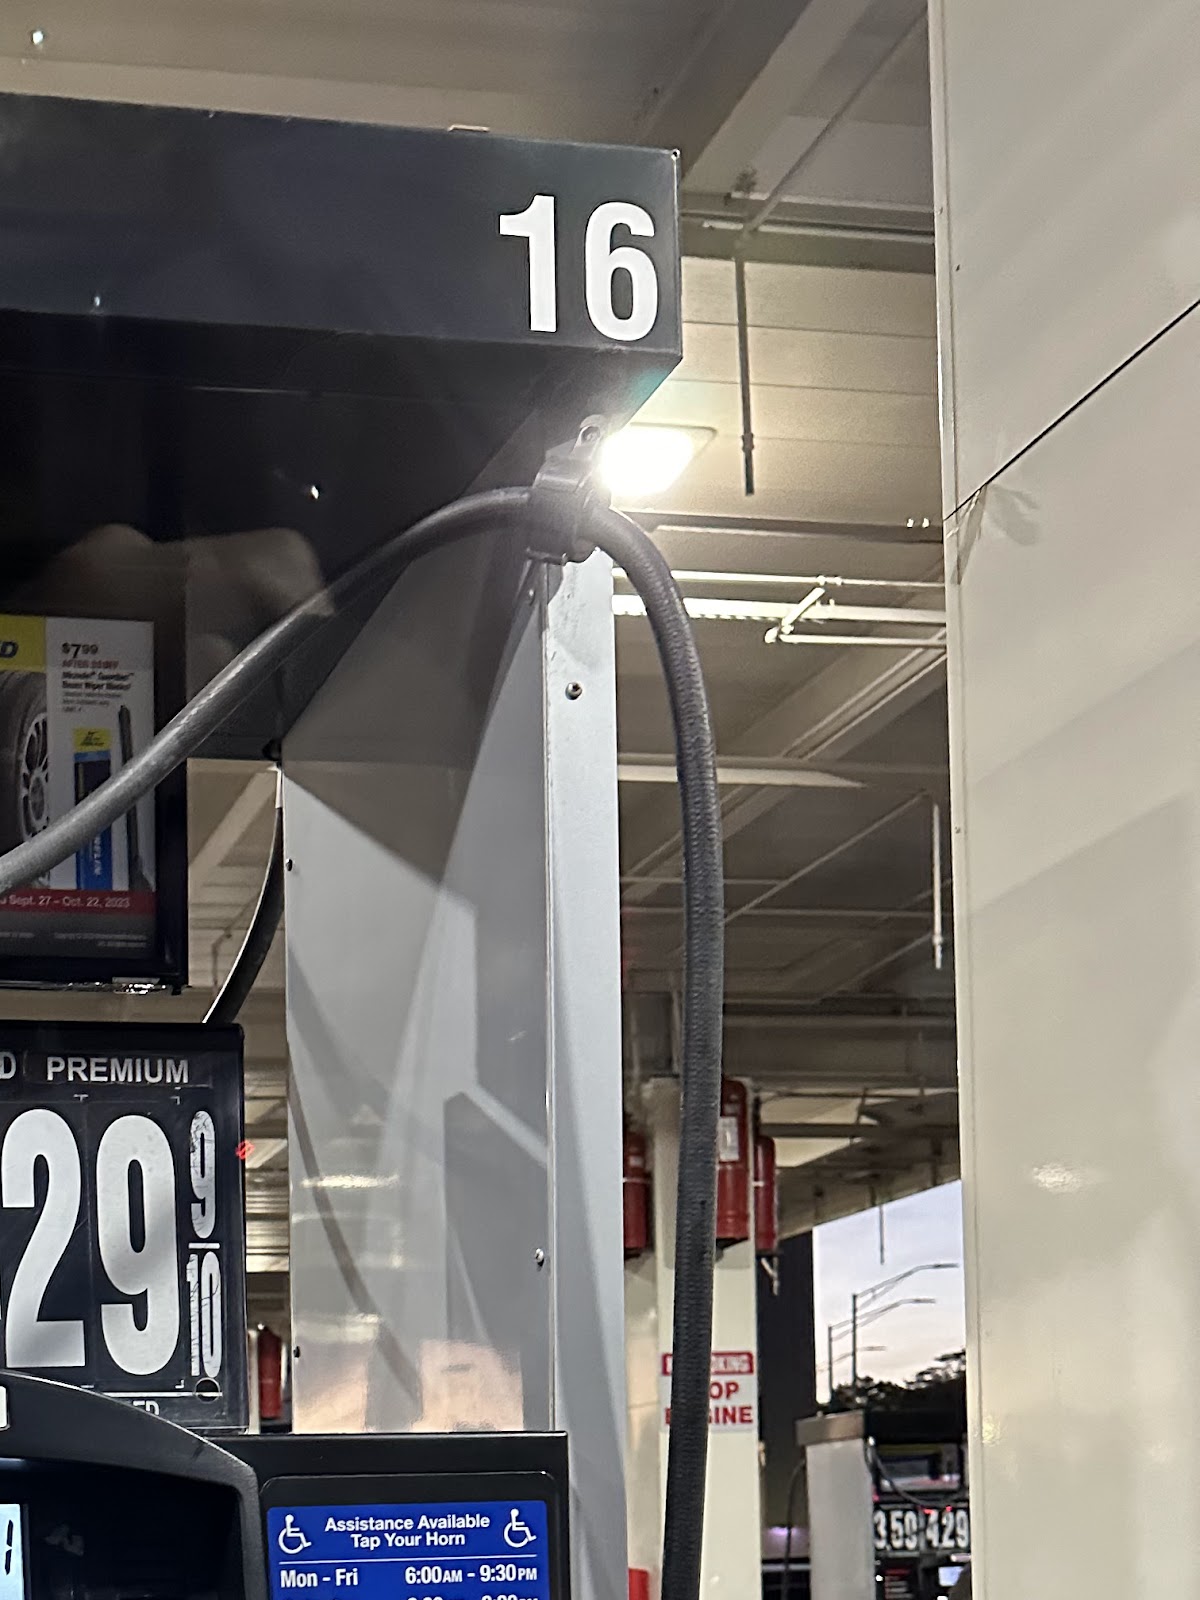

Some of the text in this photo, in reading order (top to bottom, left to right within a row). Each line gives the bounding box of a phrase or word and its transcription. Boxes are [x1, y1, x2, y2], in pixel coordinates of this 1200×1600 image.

[499, 194, 658, 341] 16
[46, 1056, 189, 1084] PREMIUM
[325, 1515, 490, 1532] Assistance Available
[350, 1531, 465, 1551] Tap Your Horn
[281, 1564, 537, 1587] Mon Fri 6:00AM 9:30PM
